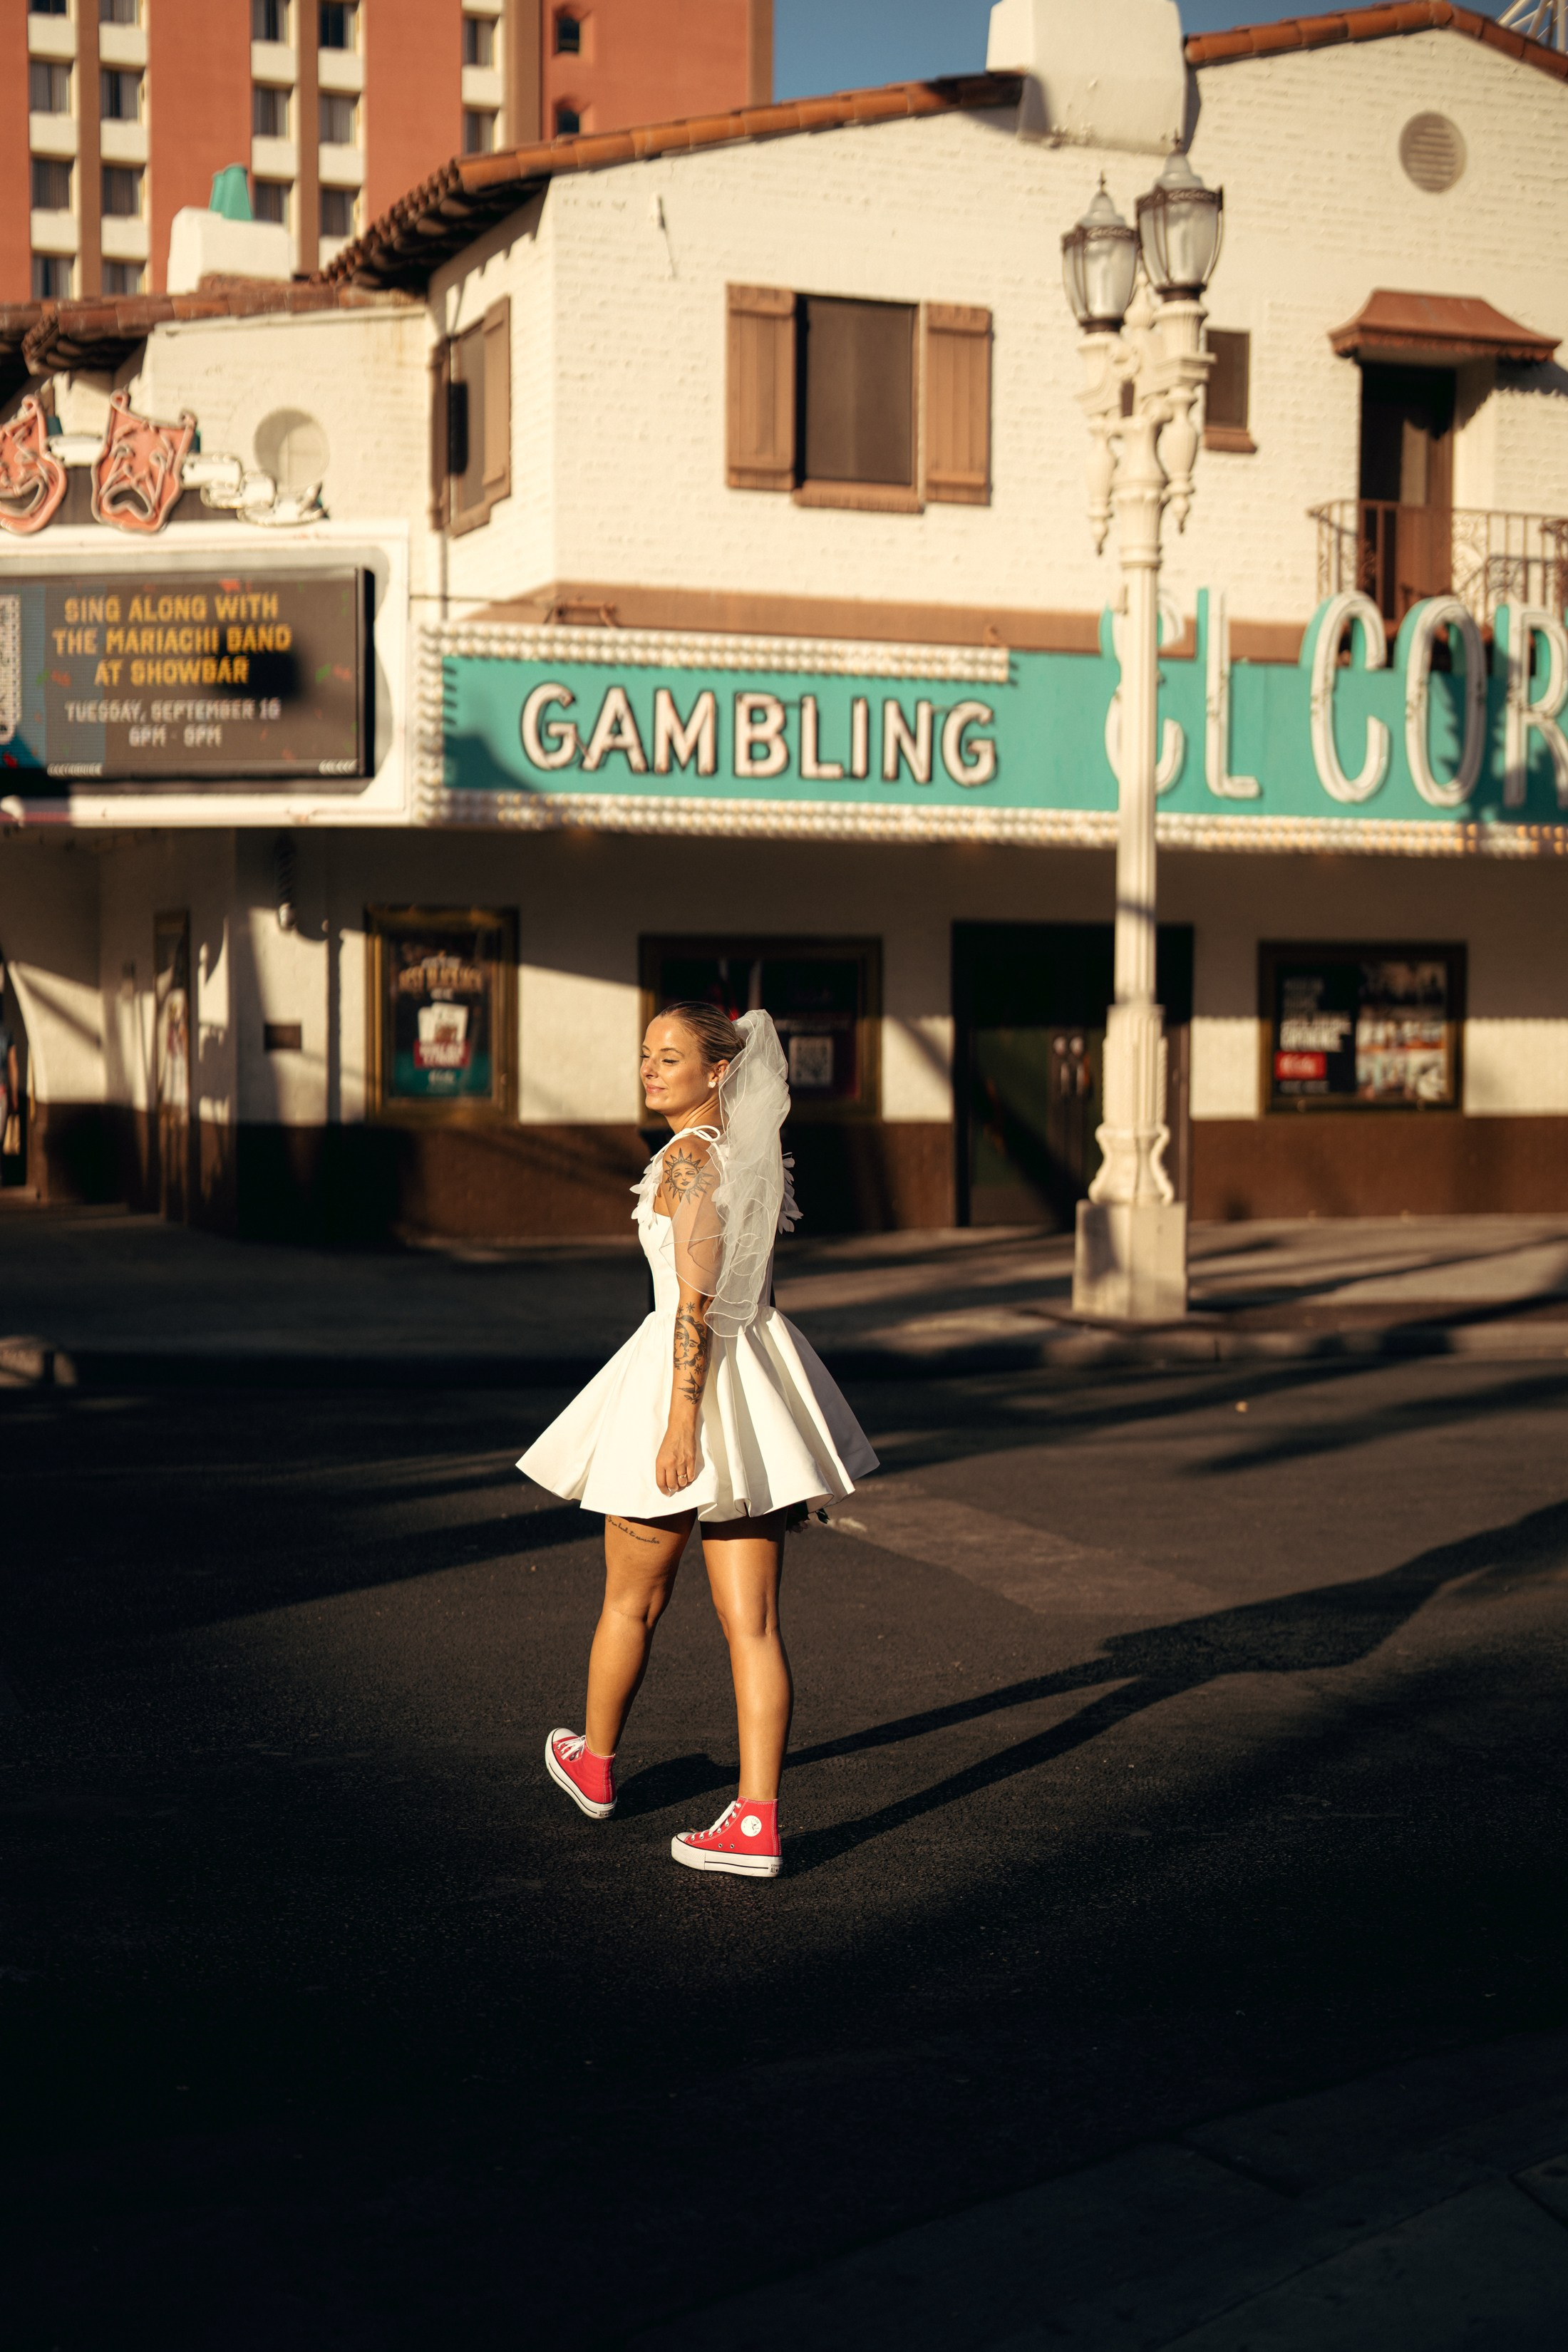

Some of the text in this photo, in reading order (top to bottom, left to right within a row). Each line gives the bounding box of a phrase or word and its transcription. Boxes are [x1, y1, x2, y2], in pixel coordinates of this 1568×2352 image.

[65, 592, 279, 623] SING ALONG WITH
[52, 624, 292, 656] THE MARIACHI BAND
[94, 656, 249, 686] AT SHOWBAR
[150, 698, 255, 722] SEPTEMBER
[520, 681, 998, 787] GAMBLING
